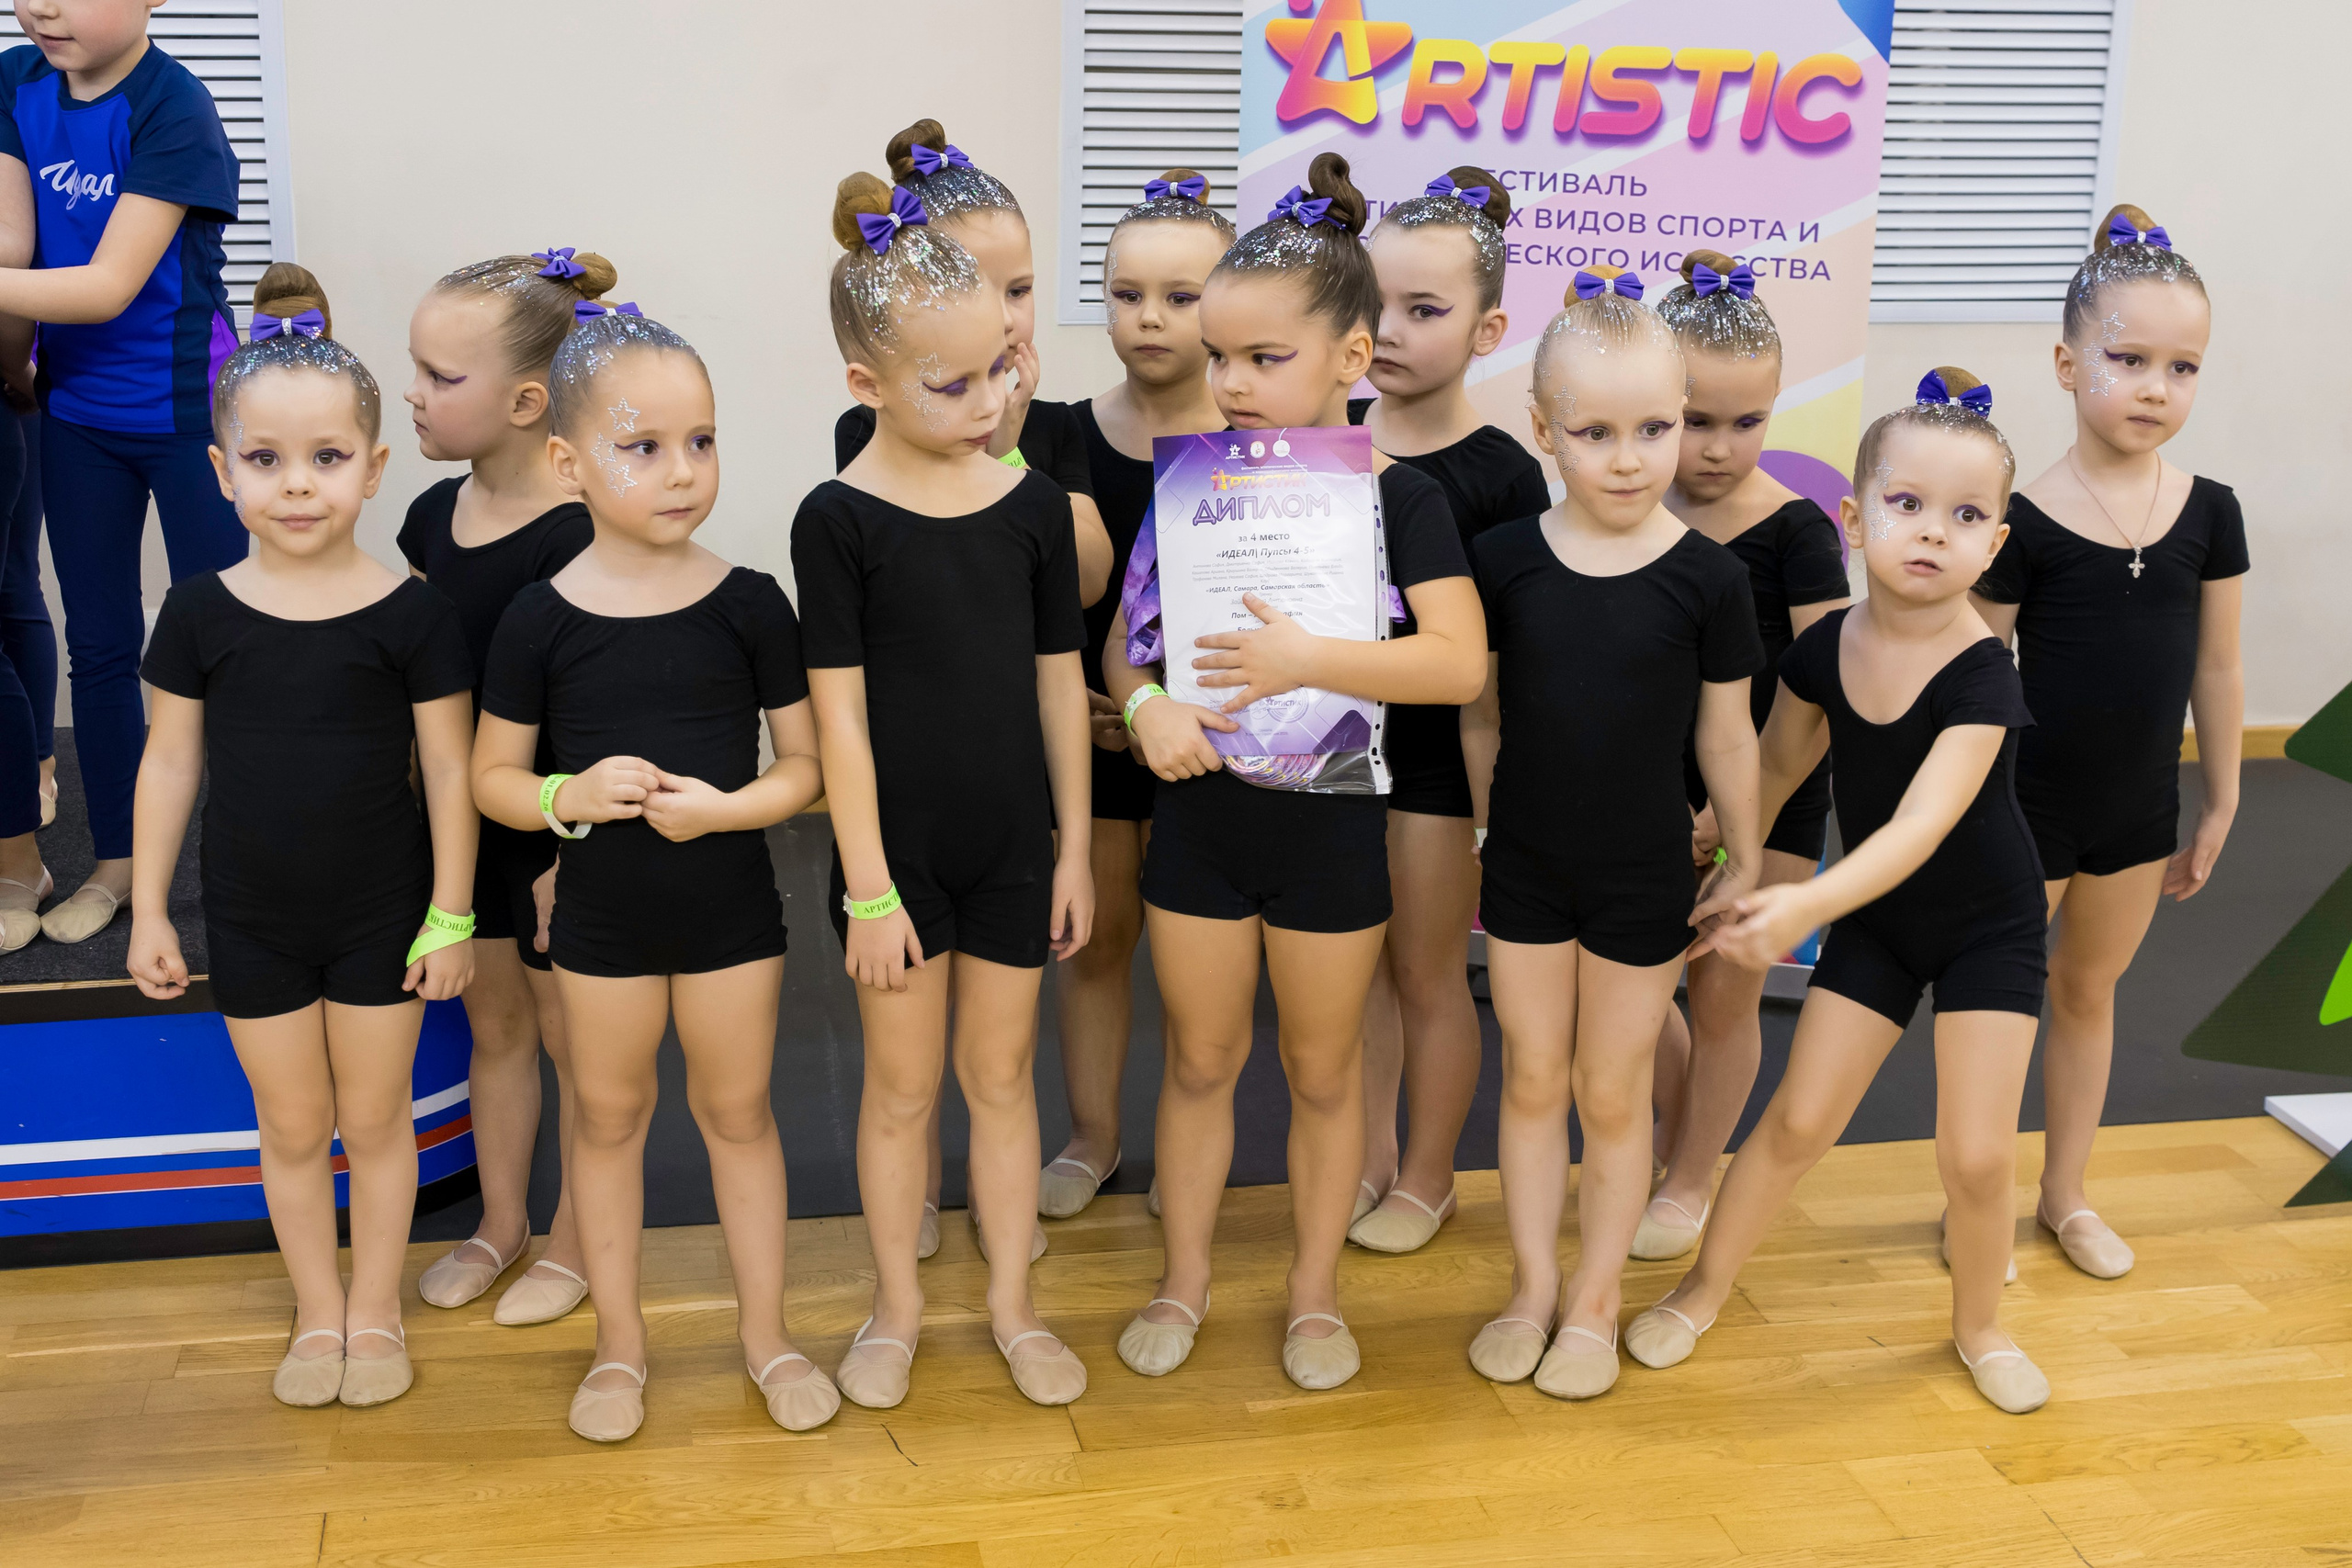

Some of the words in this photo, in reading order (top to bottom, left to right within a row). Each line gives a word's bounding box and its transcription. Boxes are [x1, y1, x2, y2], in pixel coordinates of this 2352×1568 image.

[1265, 0, 1863, 144] ARTISTIC
[1484, 169, 1647, 197] СТИВАЛЬ
[1535, 208, 1646, 235] ВИДОВ
[1657, 214, 1787, 242] СПОРТА
[1799, 221, 1820, 243] И
[1210, 469, 1308, 491] АРТИСТИК
[1193, 492, 1330, 526] ДИПЛОМ
[1250, 533, 1257, 541] 4
[1260, 533, 1290, 541] место
[1261, 547, 1292, 558] Пупсы
